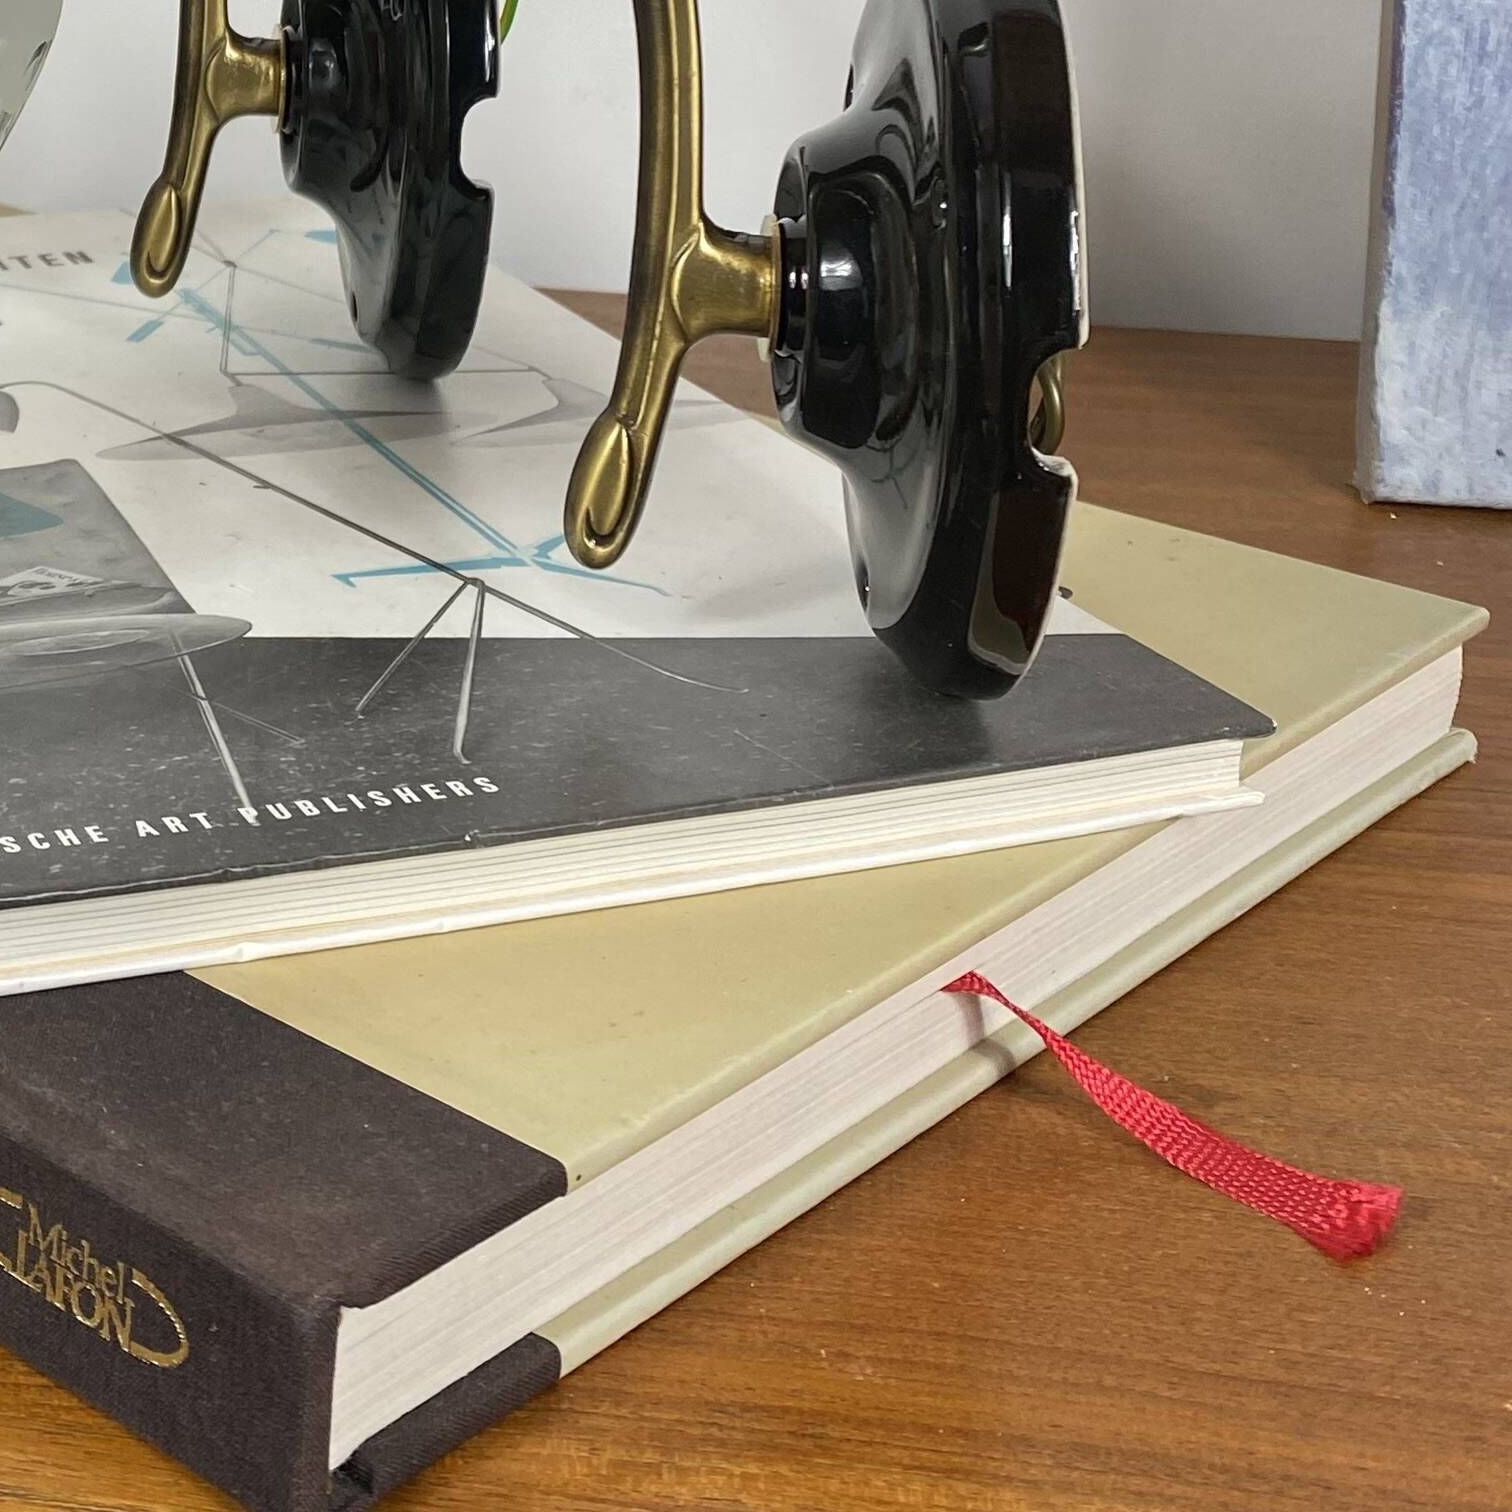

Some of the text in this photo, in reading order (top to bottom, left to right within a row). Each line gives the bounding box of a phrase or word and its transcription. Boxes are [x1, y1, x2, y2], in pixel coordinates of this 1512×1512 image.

[135, 811, 214, 838] ART
[237, 776, 500, 825] PUBLISHERS
[17, 1229, 135, 1352] LAFON
[28, 1201, 126, 1304] Michel
